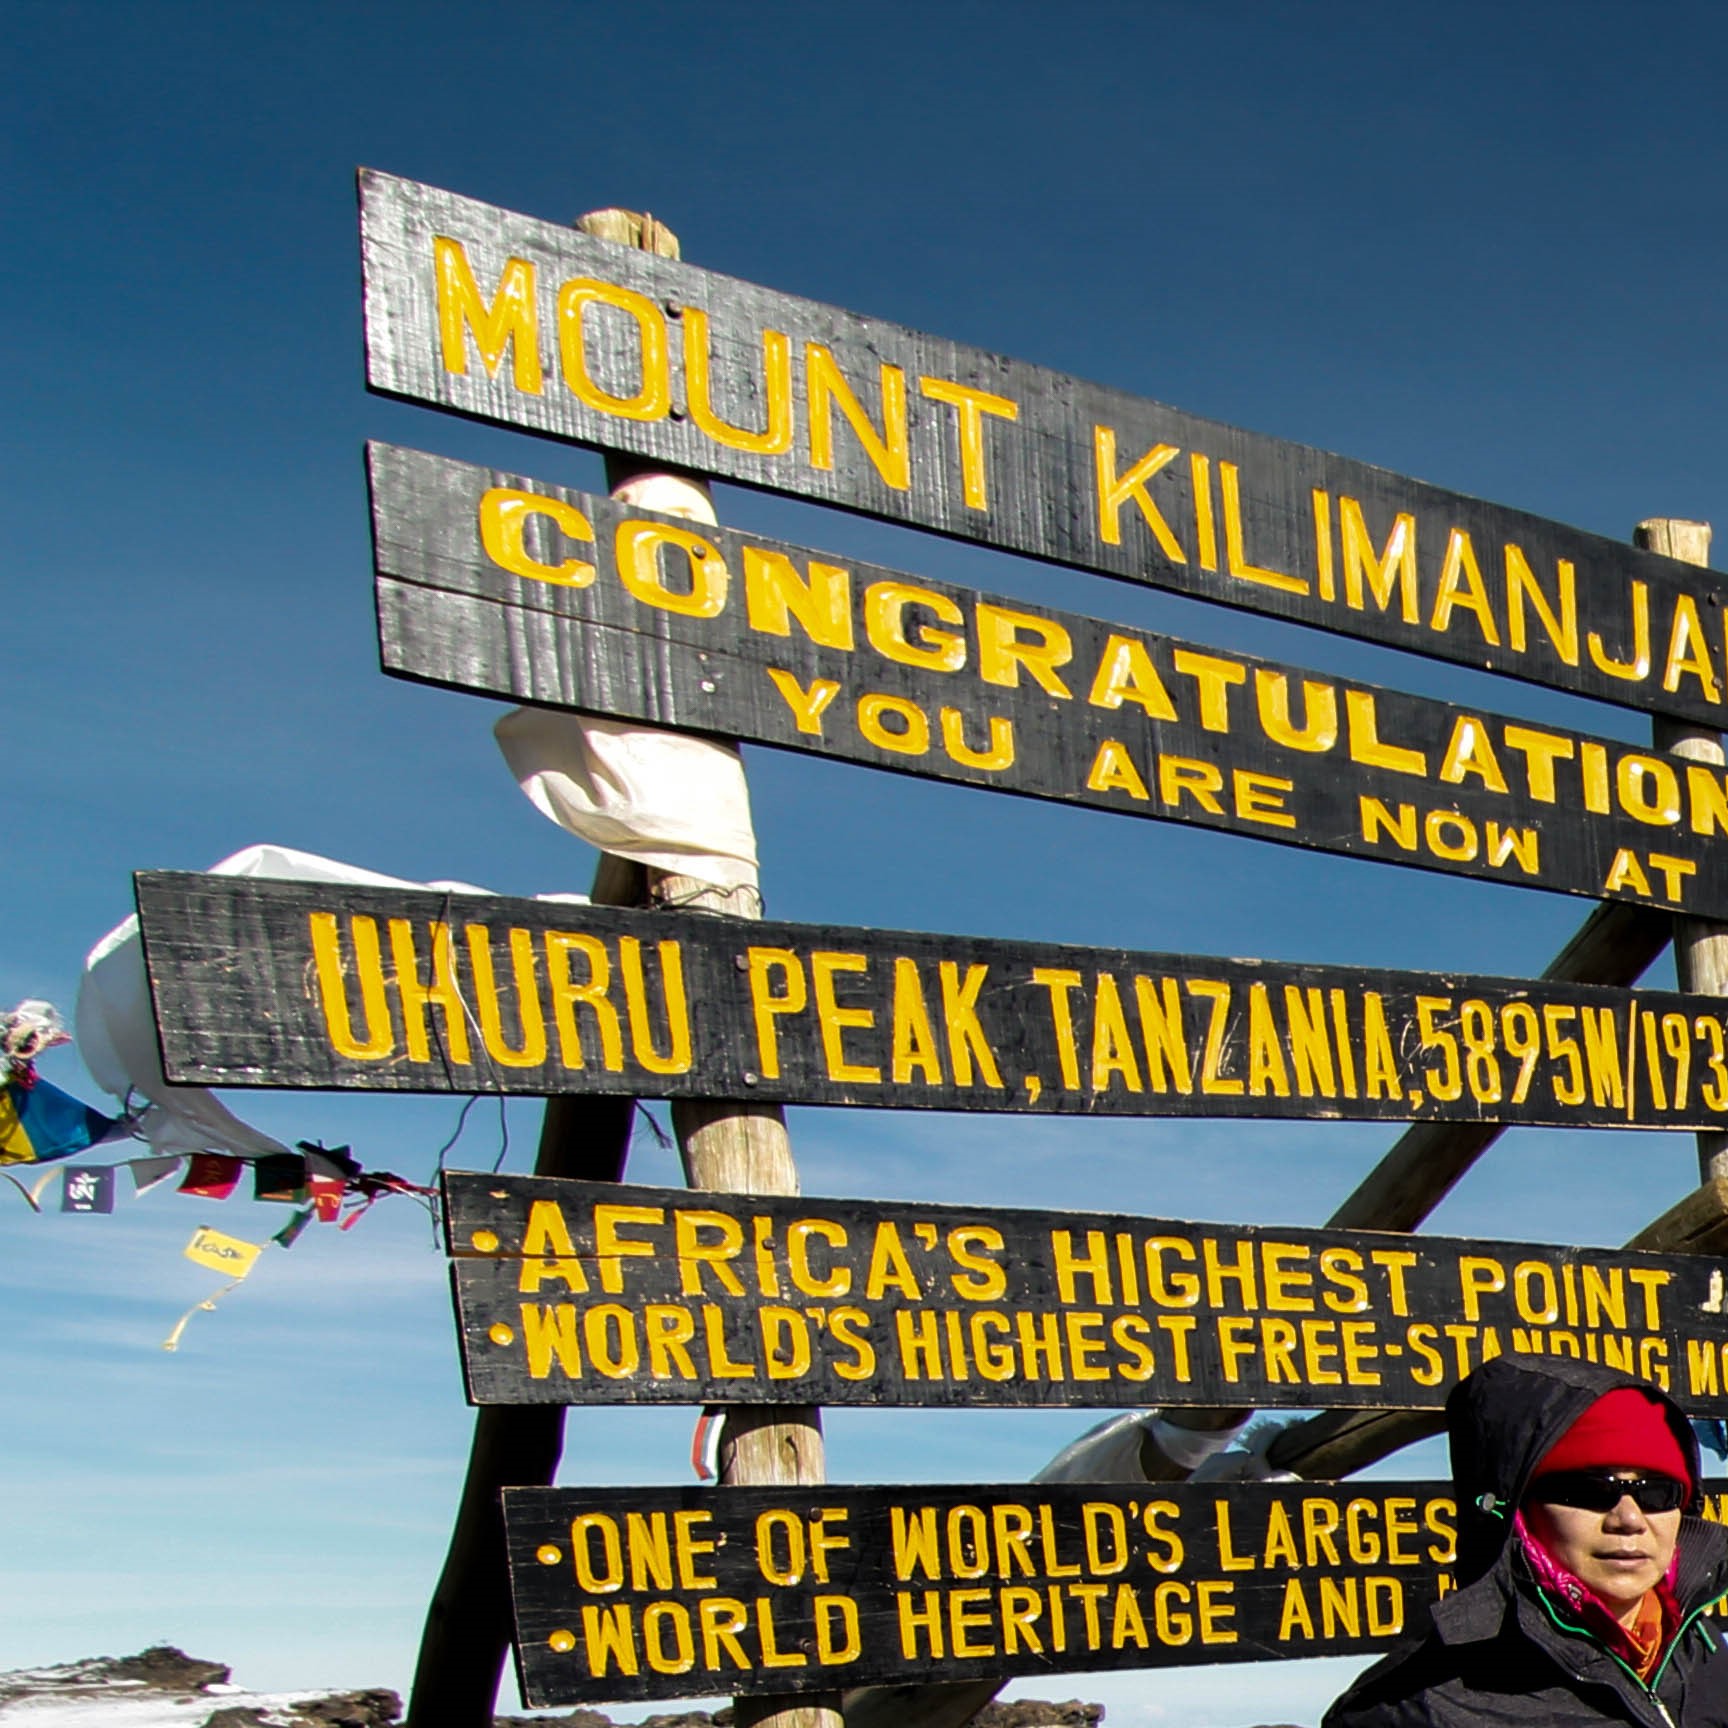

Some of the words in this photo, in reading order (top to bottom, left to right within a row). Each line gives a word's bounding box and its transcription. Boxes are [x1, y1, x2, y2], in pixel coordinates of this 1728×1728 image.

[433, 236, 1017, 510] MOUNT
[767, 668, 1016, 771] YOU
[1088, 740, 1296, 828] ARE
[1360, 795, 1539, 875] NOW
[1605, 848, 1696, 902] AT
[311, 912, 693, 1074] UHURU
[519, 1200, 1007, 1302] AFRICA'S
[1051, 1231, 1416, 1317] HIGHEST
[1459, 1256, 1671, 1331] POINT
[521, 1302, 875, 1380] WORLD'S
[896, 1310, 1196, 1382] HIGHEST
[572, 1511, 717, 1593] ONE
[756, 1508, 850, 1586] OF
[891, 1501, 1184, 1581] WORLD'S
[1216, 1498, 1457, 1571] LARGES
[582, 1596, 861, 1677] WORLD
[897, 1581, 1238, 1659] HERITAGE
[1279, 1577, 1403, 1640] AND
